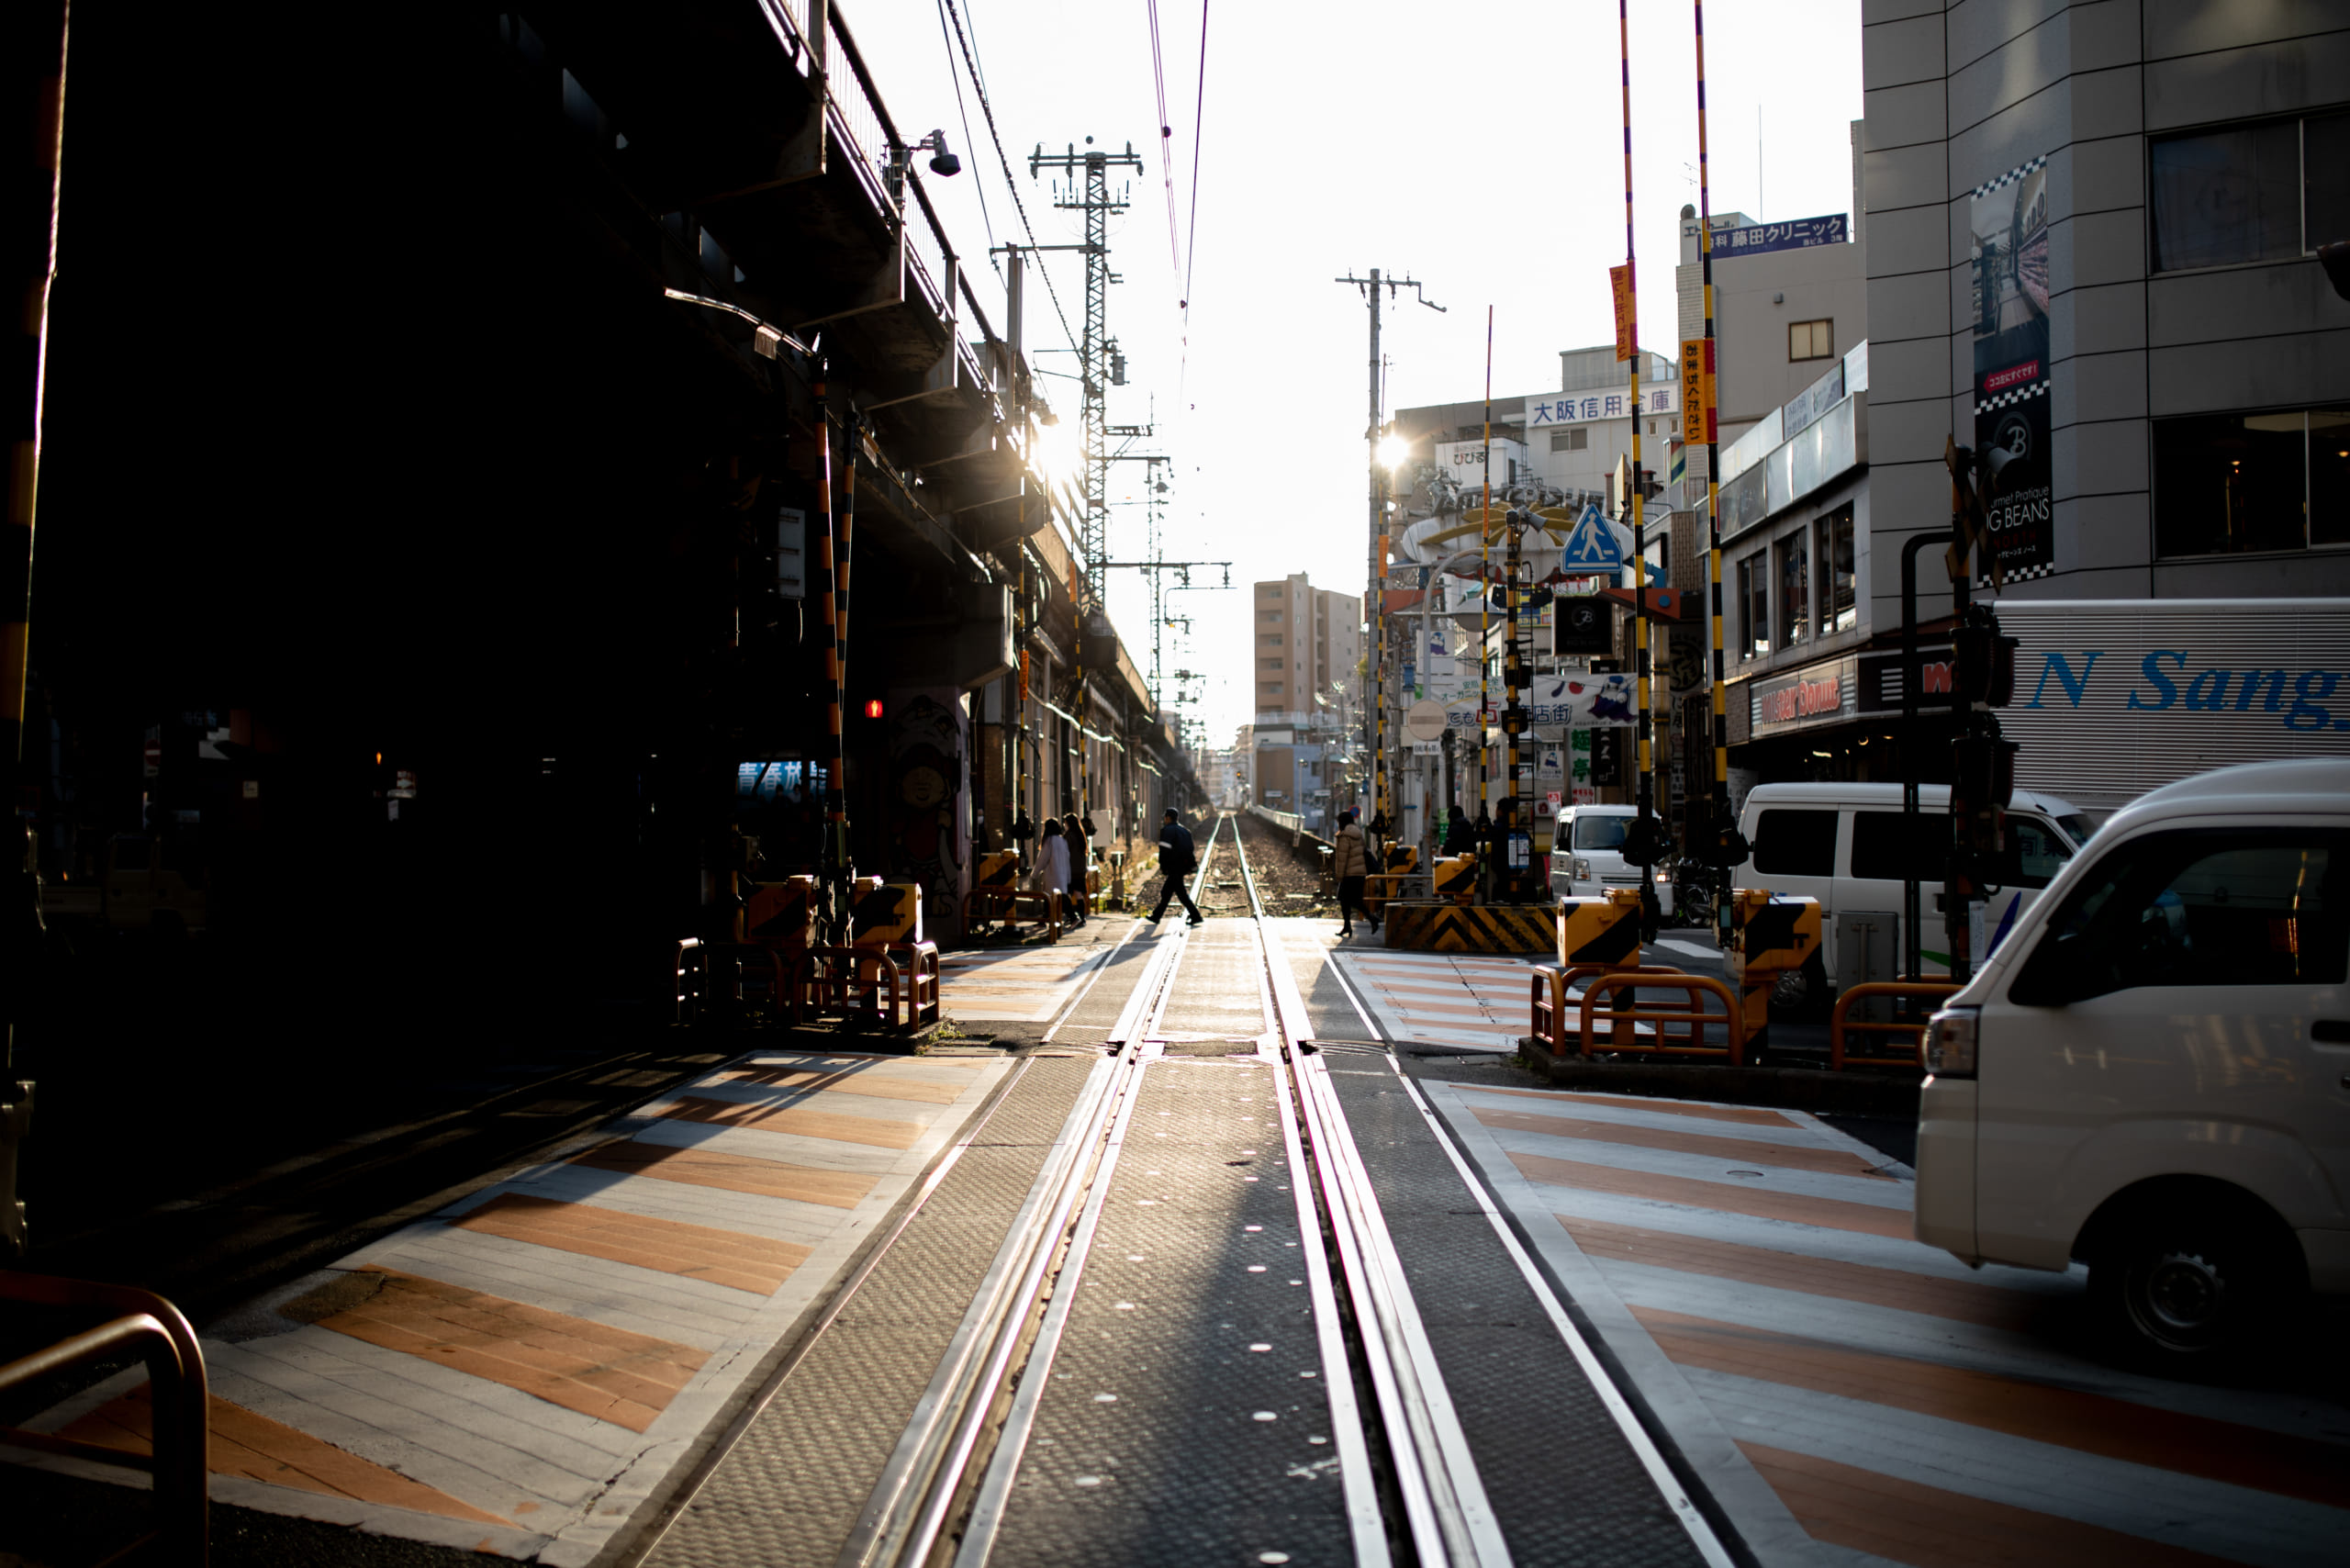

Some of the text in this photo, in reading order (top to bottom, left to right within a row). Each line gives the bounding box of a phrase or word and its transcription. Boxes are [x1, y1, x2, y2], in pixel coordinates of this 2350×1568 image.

[1731, 217, 1841, 248] 藤田クリニック
[1534, 390, 1670, 424] 大阪信用金庫
[1686, 344, 1700, 441] おまちください
[2015, 486, 2049, 504] Pratique
[1986, 498, 2049, 532] IG BEANS
[1441, 686, 1508, 702] オーガニッストリ
[2024, 653, 2105, 709] N
[2127, 651, 2350, 732] Sang
[738, 761, 828, 792] 青春放
